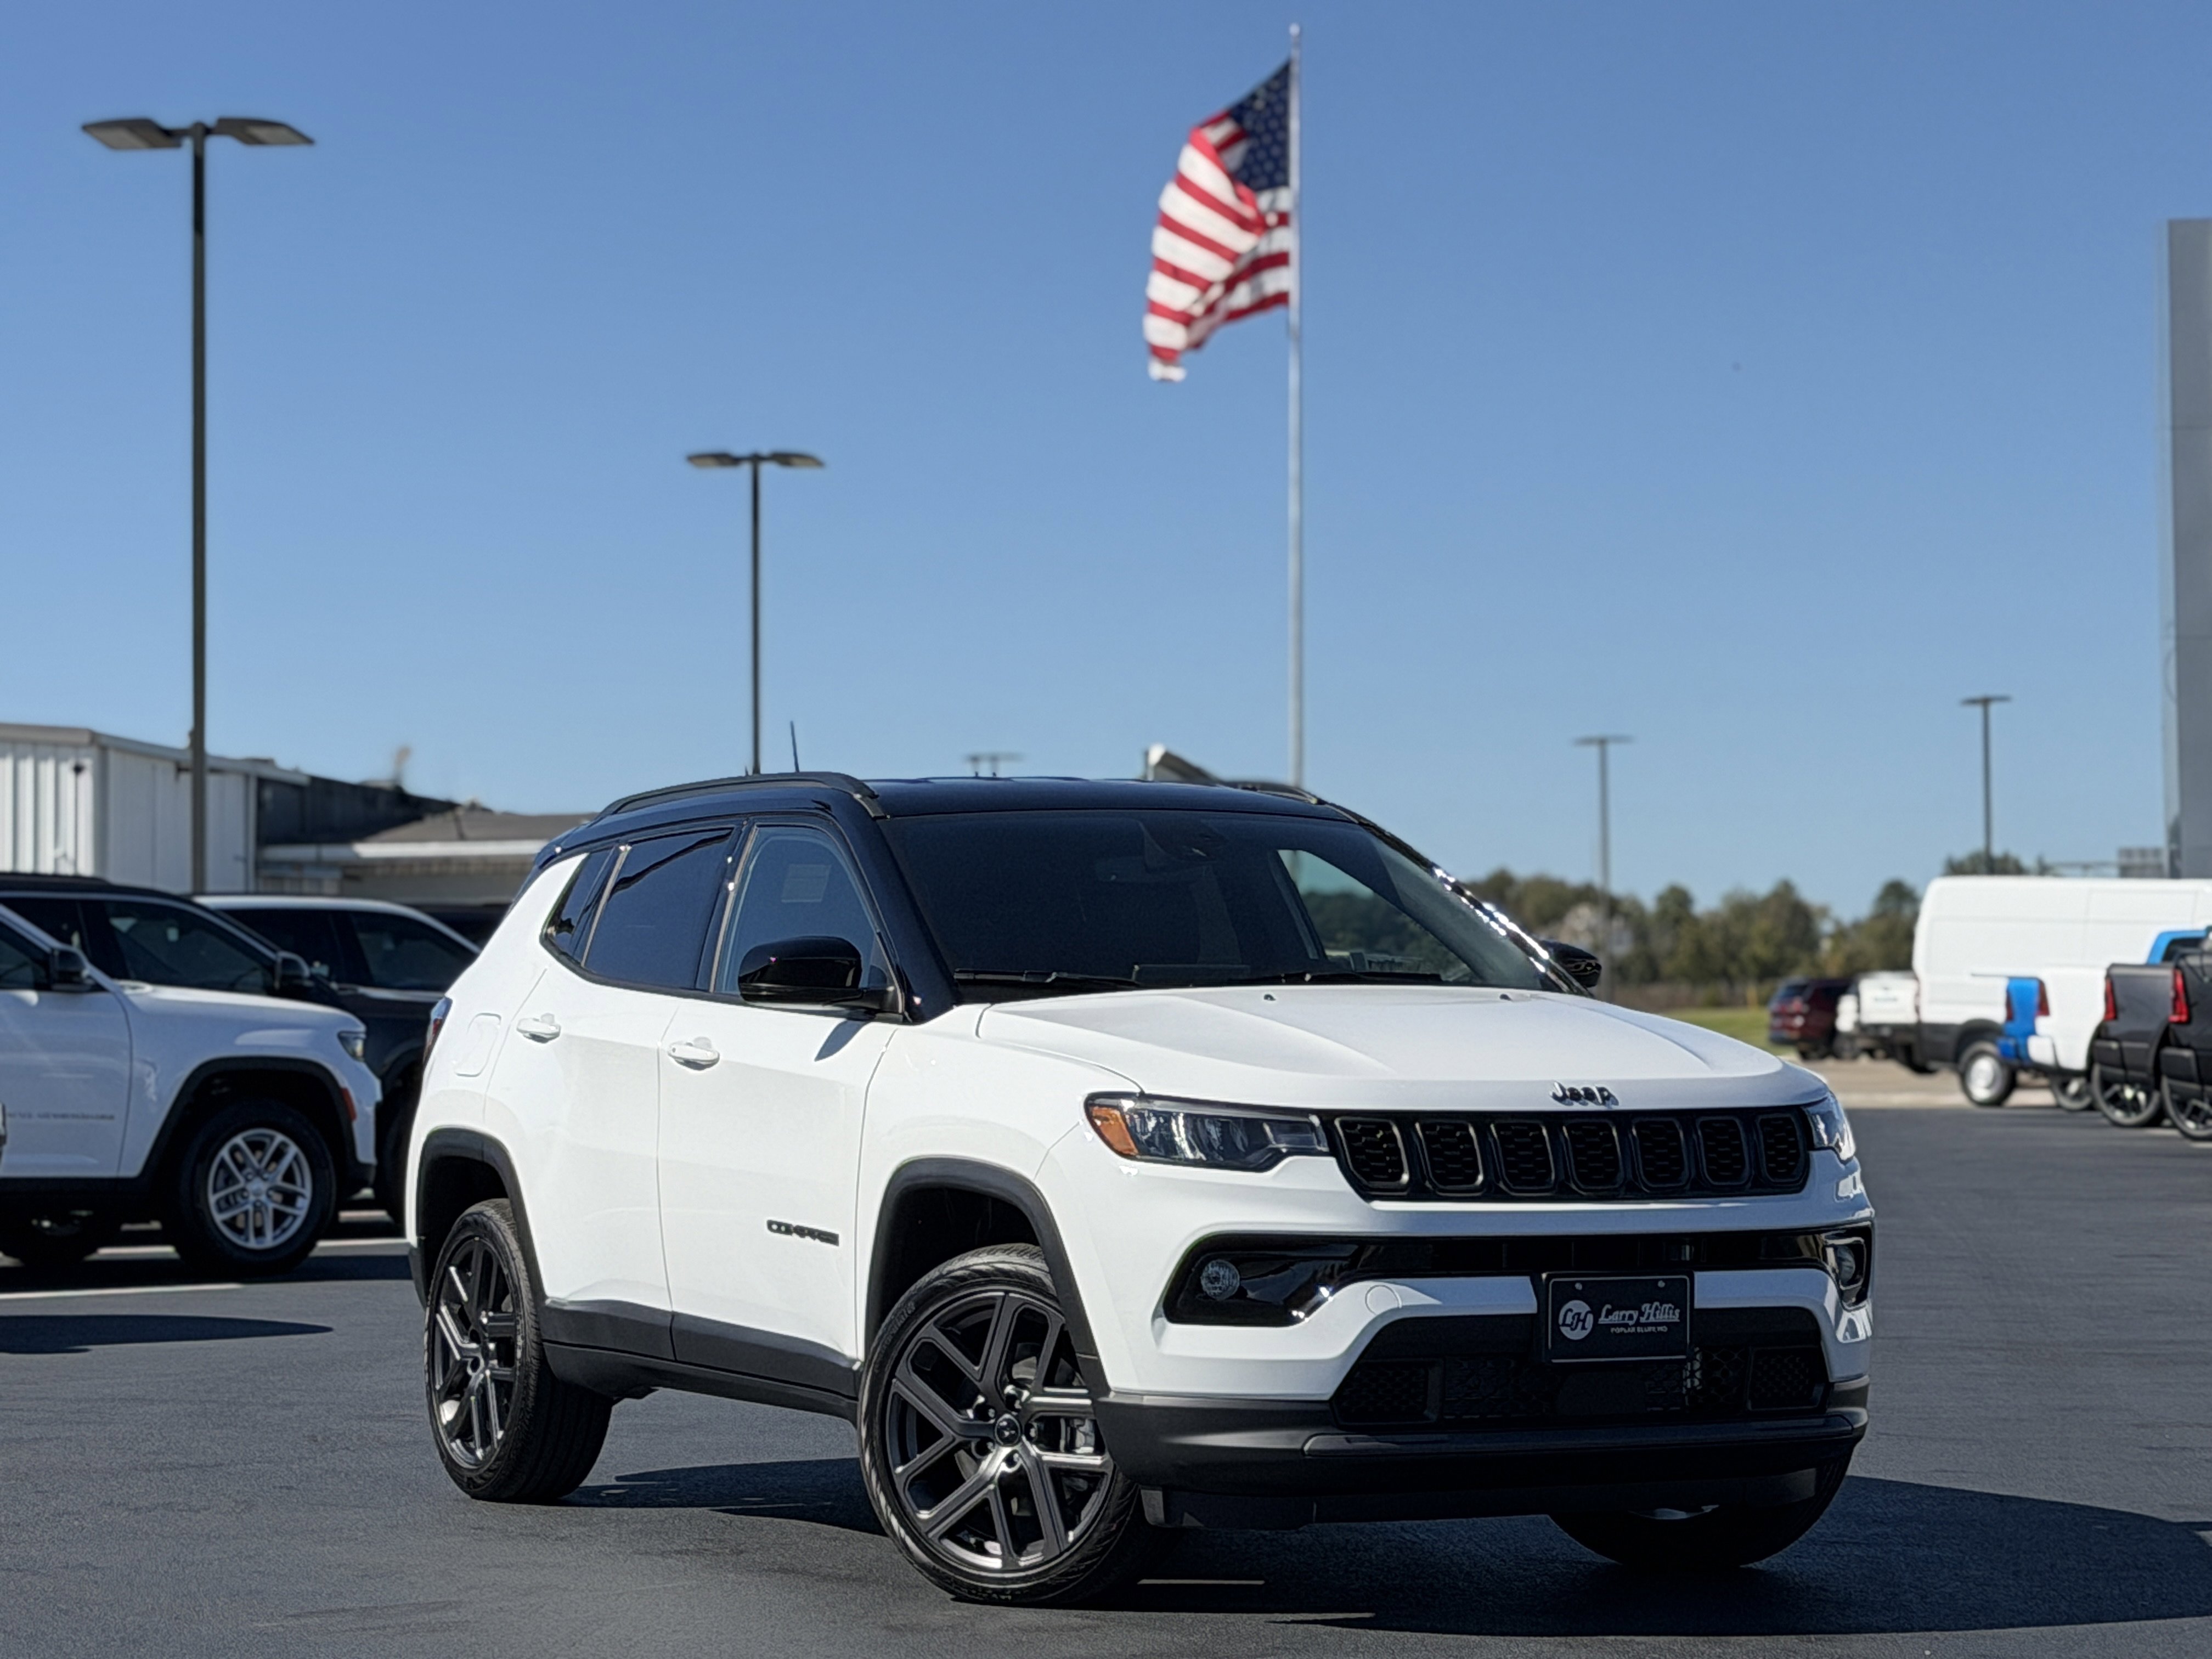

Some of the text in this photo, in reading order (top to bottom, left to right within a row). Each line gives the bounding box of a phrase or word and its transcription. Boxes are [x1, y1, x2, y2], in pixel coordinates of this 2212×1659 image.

[1549, 1081, 1619, 1108] Jeep
[1598, 1302, 1680, 1325] Larry Hillis
